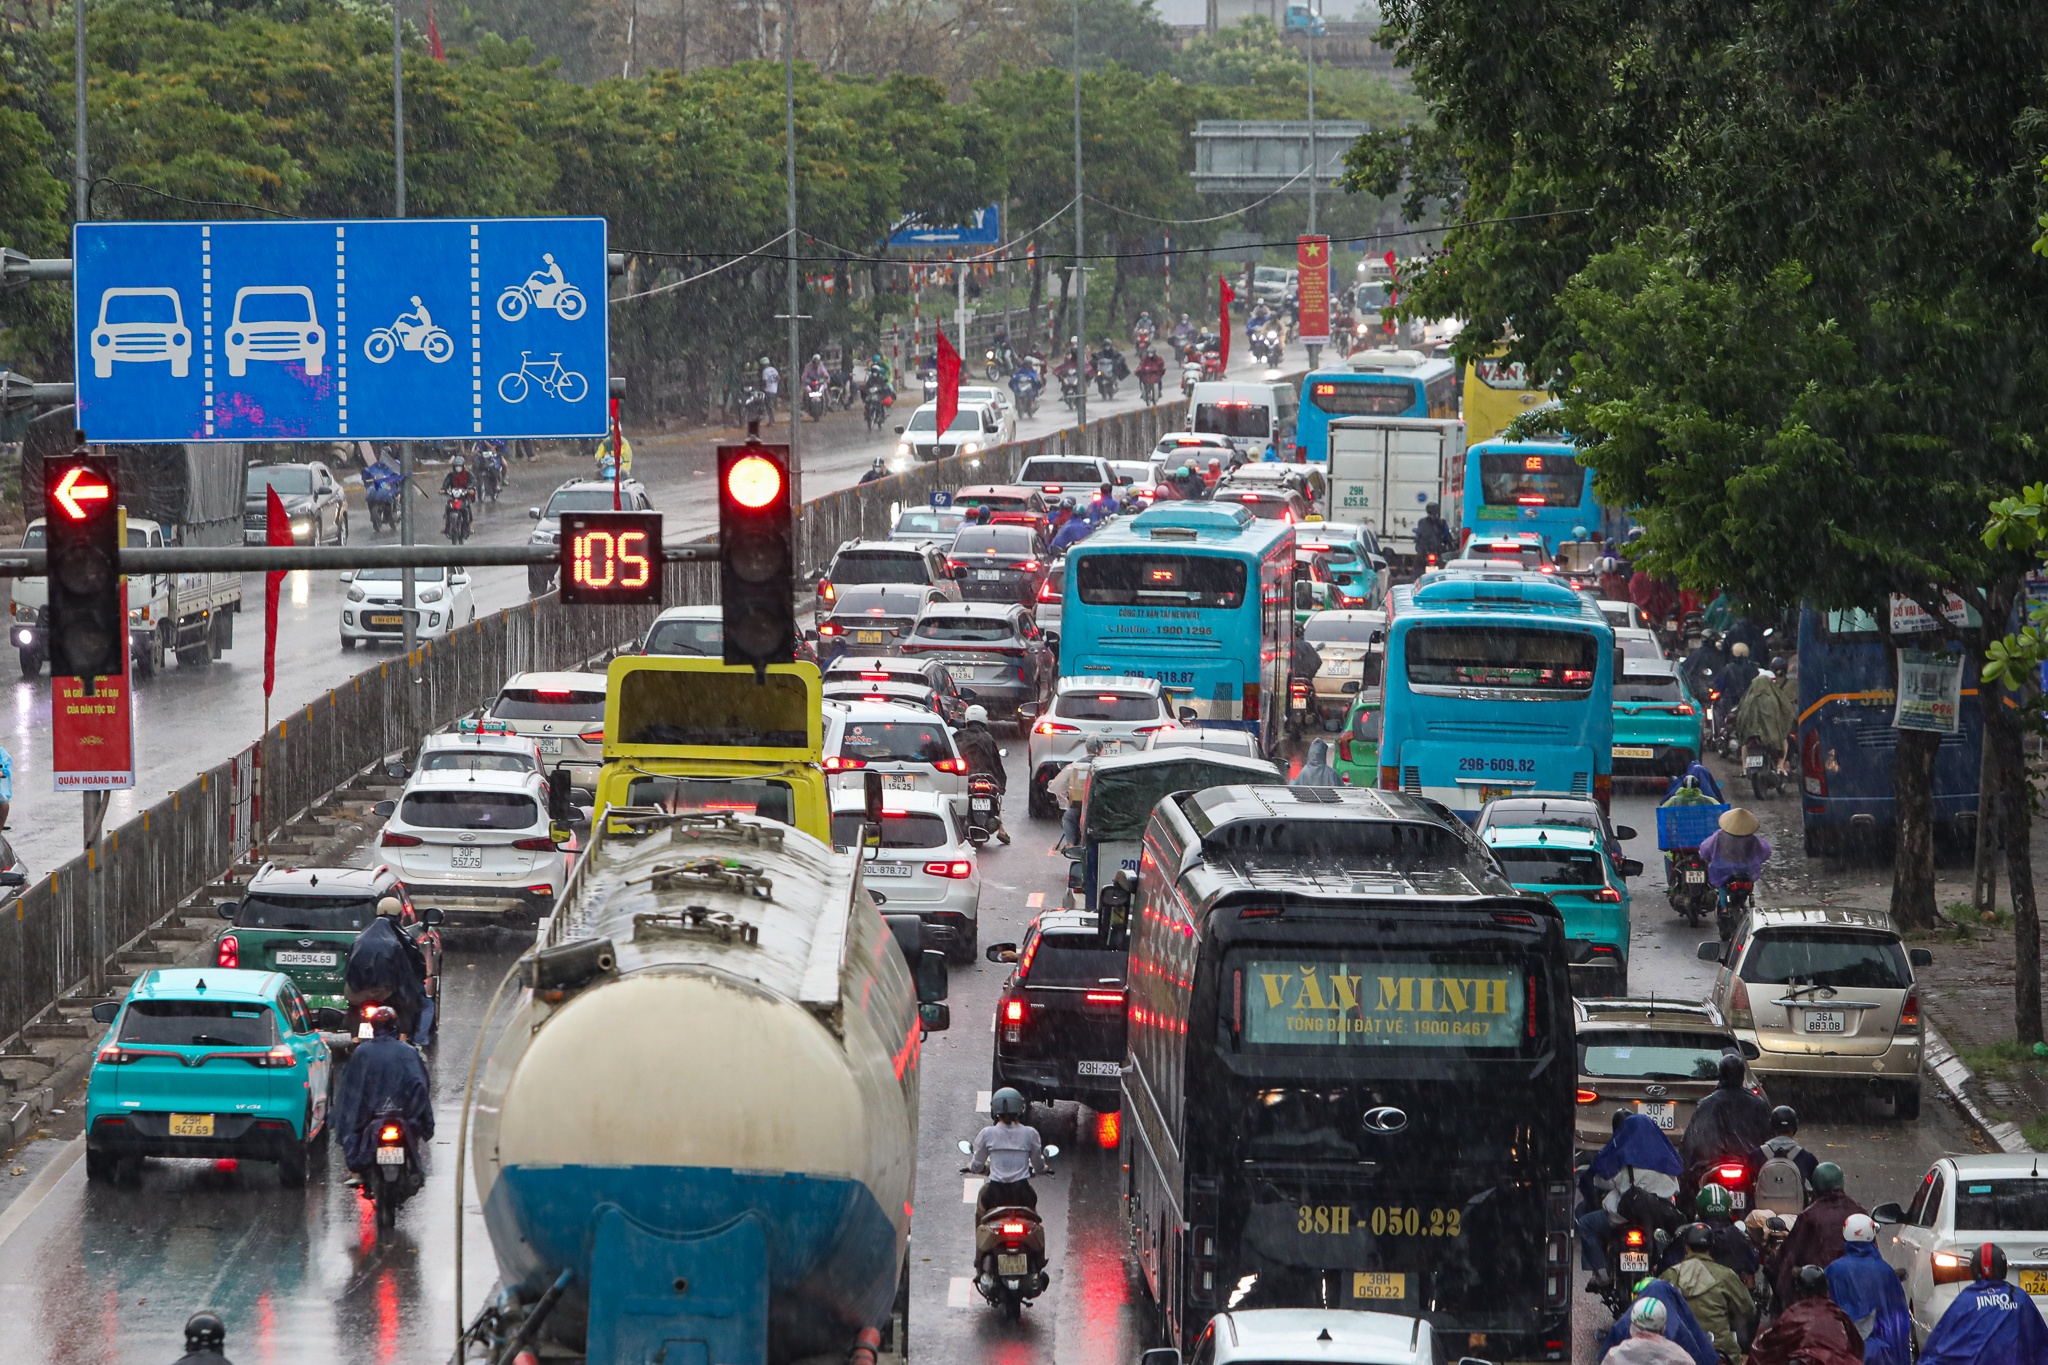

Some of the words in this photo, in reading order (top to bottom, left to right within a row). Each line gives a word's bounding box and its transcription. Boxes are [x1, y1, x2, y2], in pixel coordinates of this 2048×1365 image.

[1349, 486, 1364, 496] 29H
[1343, 497, 1369, 507] 825.82
[573, 531, 649, 587] 105
[1157, 626, 1183, 635] 1900
[1186, 627, 1212, 636] 1296
[1156, 671, 1195, 683] 618.87
[1459, 757, 1535, 773] 29B-609.82
[58, 775, 80, 787] QUẬN
[82, 774, 109, 785] HOÀNG
[111, 776, 127, 785] MAI
[452, 857, 481, 867] 557.75
[281, 953, 332, 964] 30H-594.69
[1260, 965, 1362, 1011] VĂN
[1374, 976, 1510, 1014] MINH
[1816, 1012, 1833, 1021] 36A
[1286, 1011, 1323, 1032] TỔNG
[1327, 1014, 1351, 1033] ĐÀI
[1354, 1016, 1382, 1036] ĐẶT
[1414, 1020, 1449, 1035] 1900
[1453, 1021, 1490, 1036] 6467
[1809, 1022, 1841, 1031] 883.08
[1646, 1104, 1666, 1116] 30F
[182, 1115, 201, 1125] 29H
[174, 1125, 208, 1135] 947.69
[1297, 1205, 1350, 1235] 38H
[1371, 1205, 1461, 1237] 050.22
[1622, 1262, 1648, 1270] 050.37
[1368, 1274, 1391, 1285] 38H
[2034, 1271, 2048, 1281] 29
[1359, 1286, 1400, 1298] 050.22
[2025, 1282, 2048, 1294] 024.
[1976, 1293, 2010, 1311] JINRO
